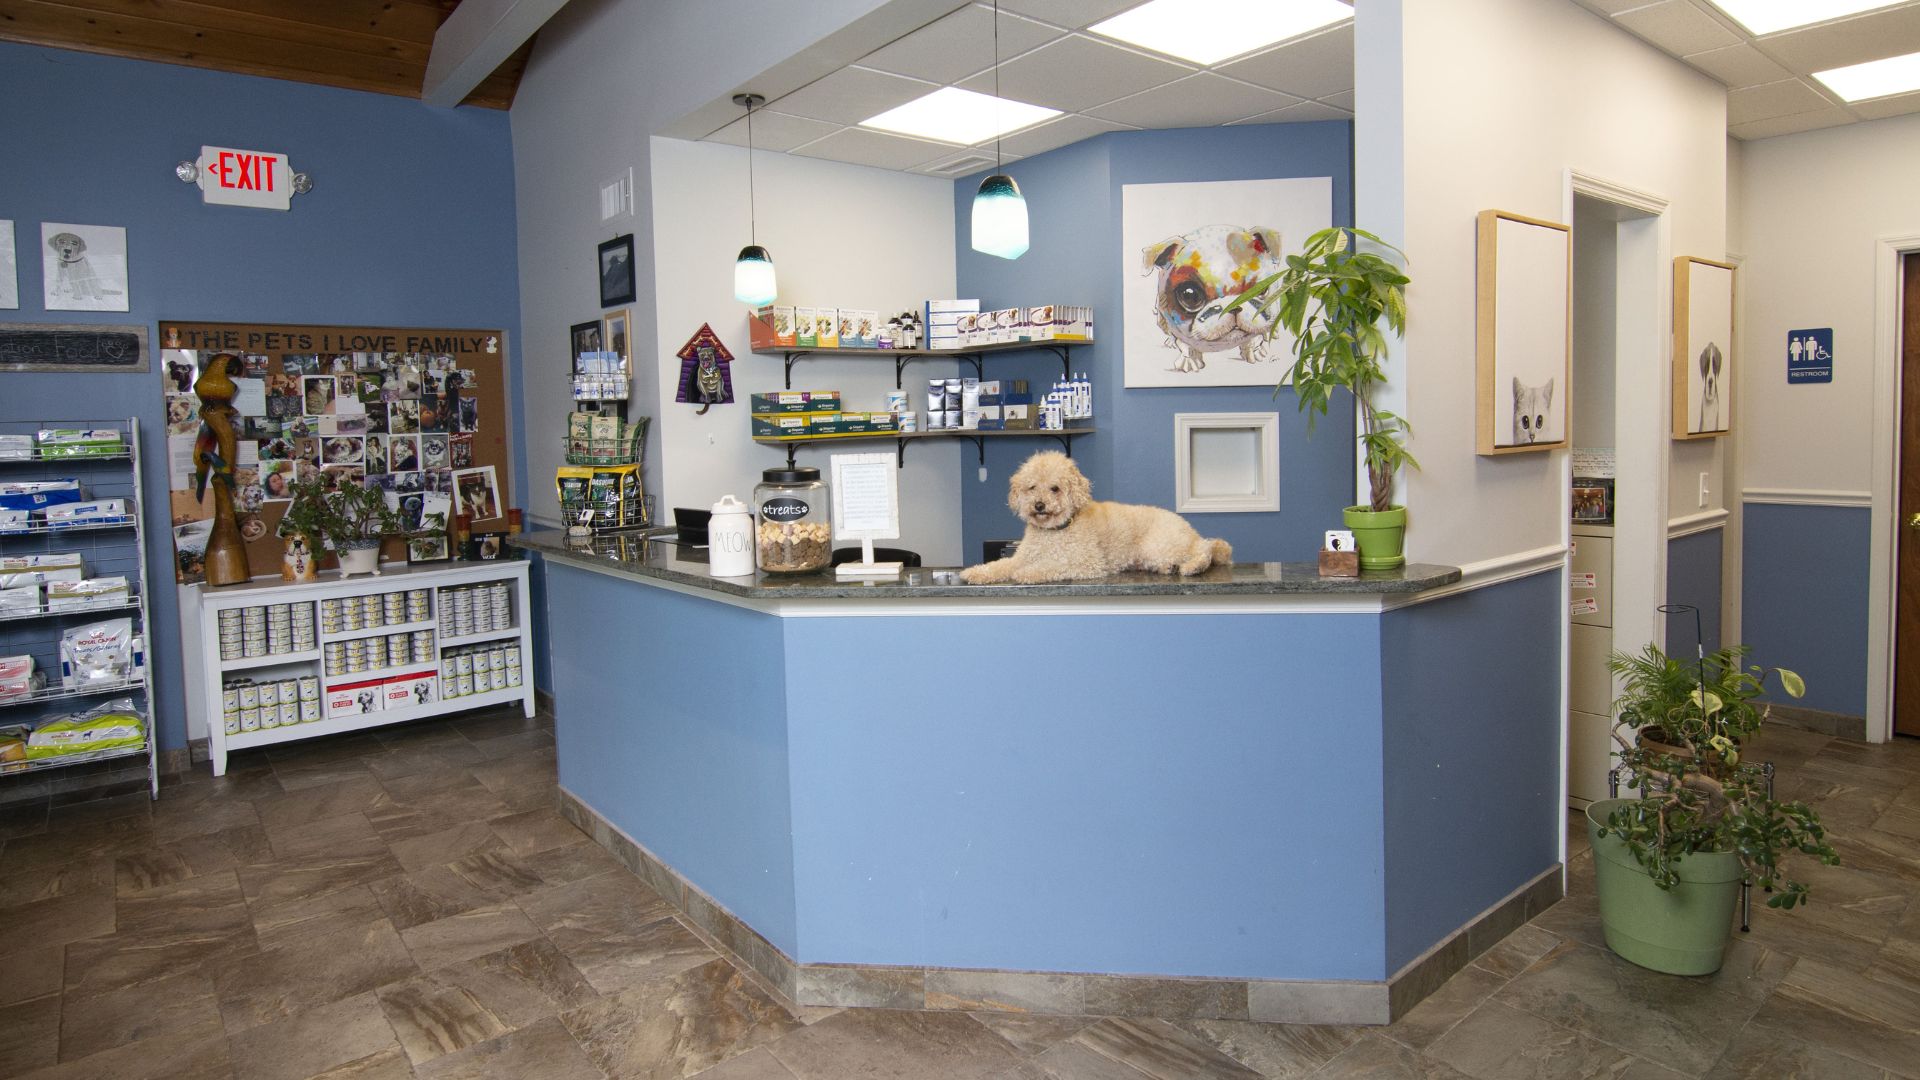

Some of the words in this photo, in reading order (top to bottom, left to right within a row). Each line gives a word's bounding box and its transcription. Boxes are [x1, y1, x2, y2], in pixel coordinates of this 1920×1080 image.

[219, 151, 277, 192] EXIT
[54, 335, 99, 359] Food
[185, 330, 240, 349] THE
[249, 332, 312, 350] PETS
[323, 334, 329, 350] I
[339, 334, 396, 351] LOVE
[406, 336, 483, 352] FAMILY
[768, 505, 801, 515] treats
[714, 531, 751, 553] MEOW
